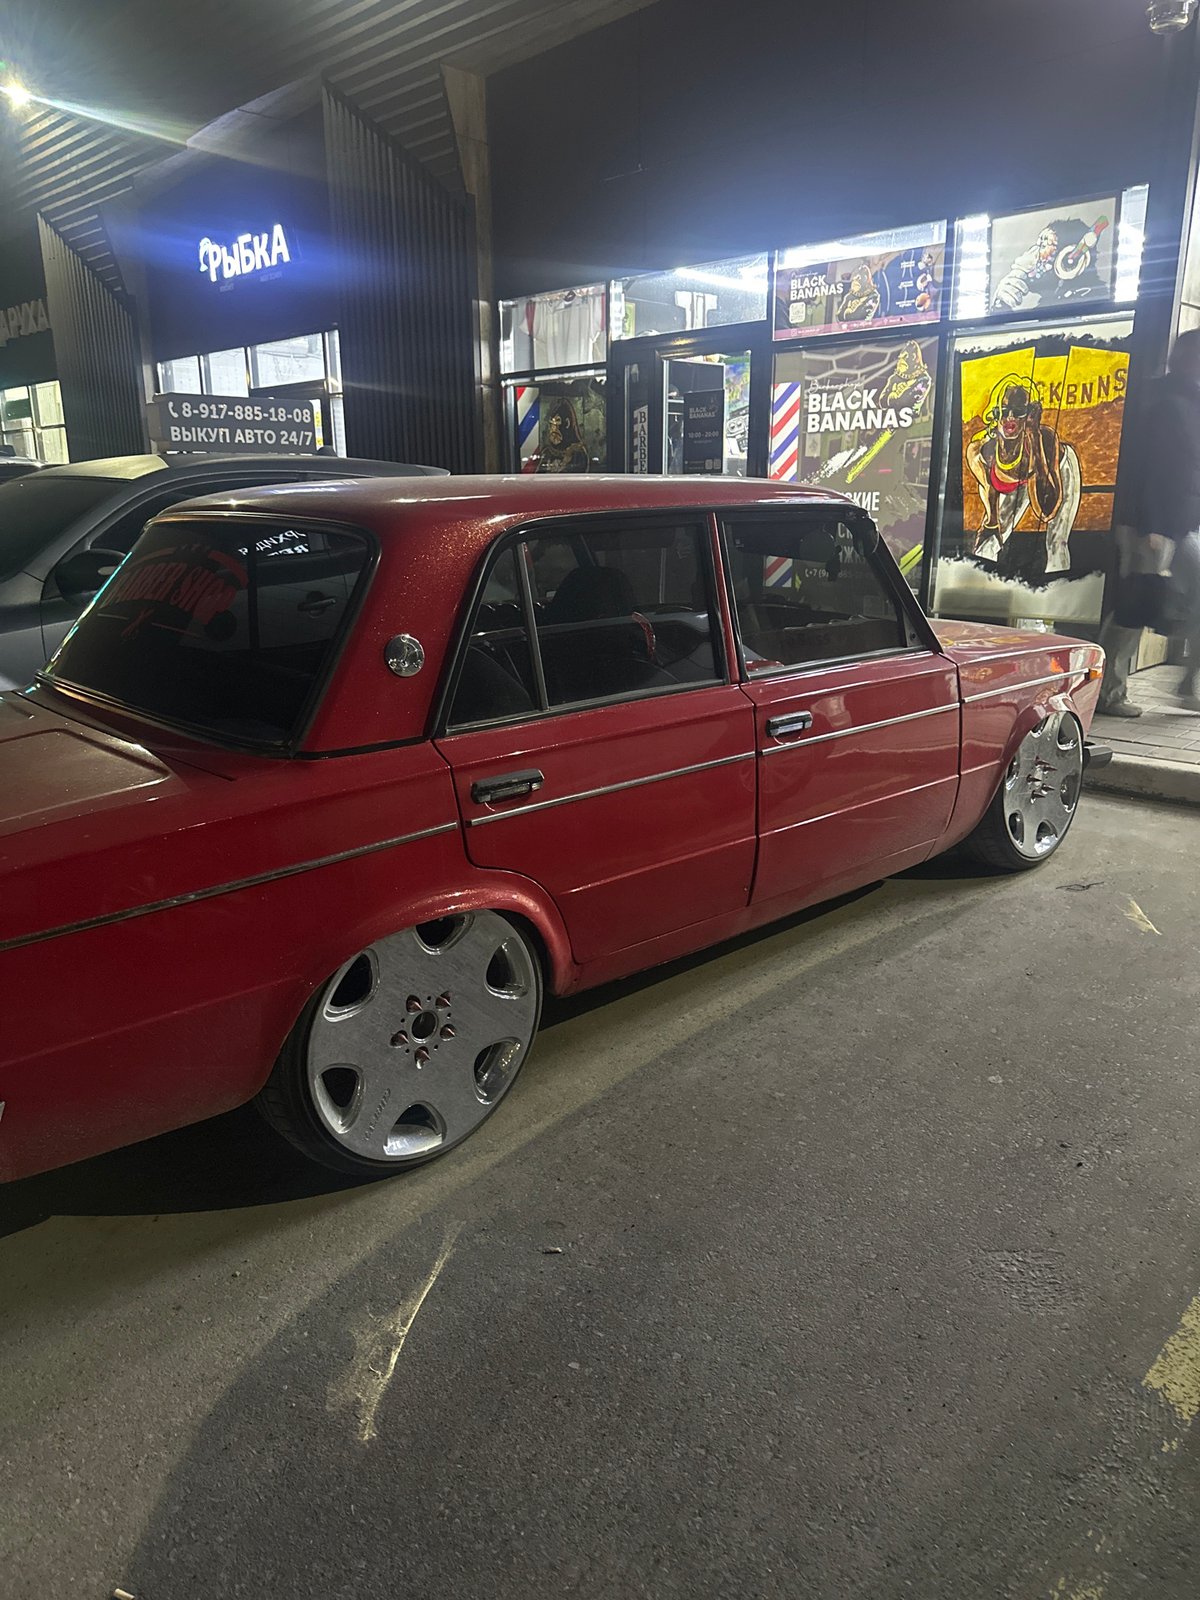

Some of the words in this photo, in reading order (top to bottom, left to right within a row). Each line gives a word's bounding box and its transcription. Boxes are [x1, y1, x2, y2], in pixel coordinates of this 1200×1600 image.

[207, 223, 291, 283] РЫБКА
[789, 283, 844, 301] BANANAS
[790, 274, 827, 290] BLACK
[808, 388, 878, 413] BLACK
[181, 402, 312, 424] 8-917-885-18-08
[807, 407, 913, 433] BANANAS
[170, 426, 231, 444] ВЫКУП
[234, 428, 276, 445] АВТО
[280, 430, 313, 447] 24/7
[638, 410, 647, 474] BARBE
